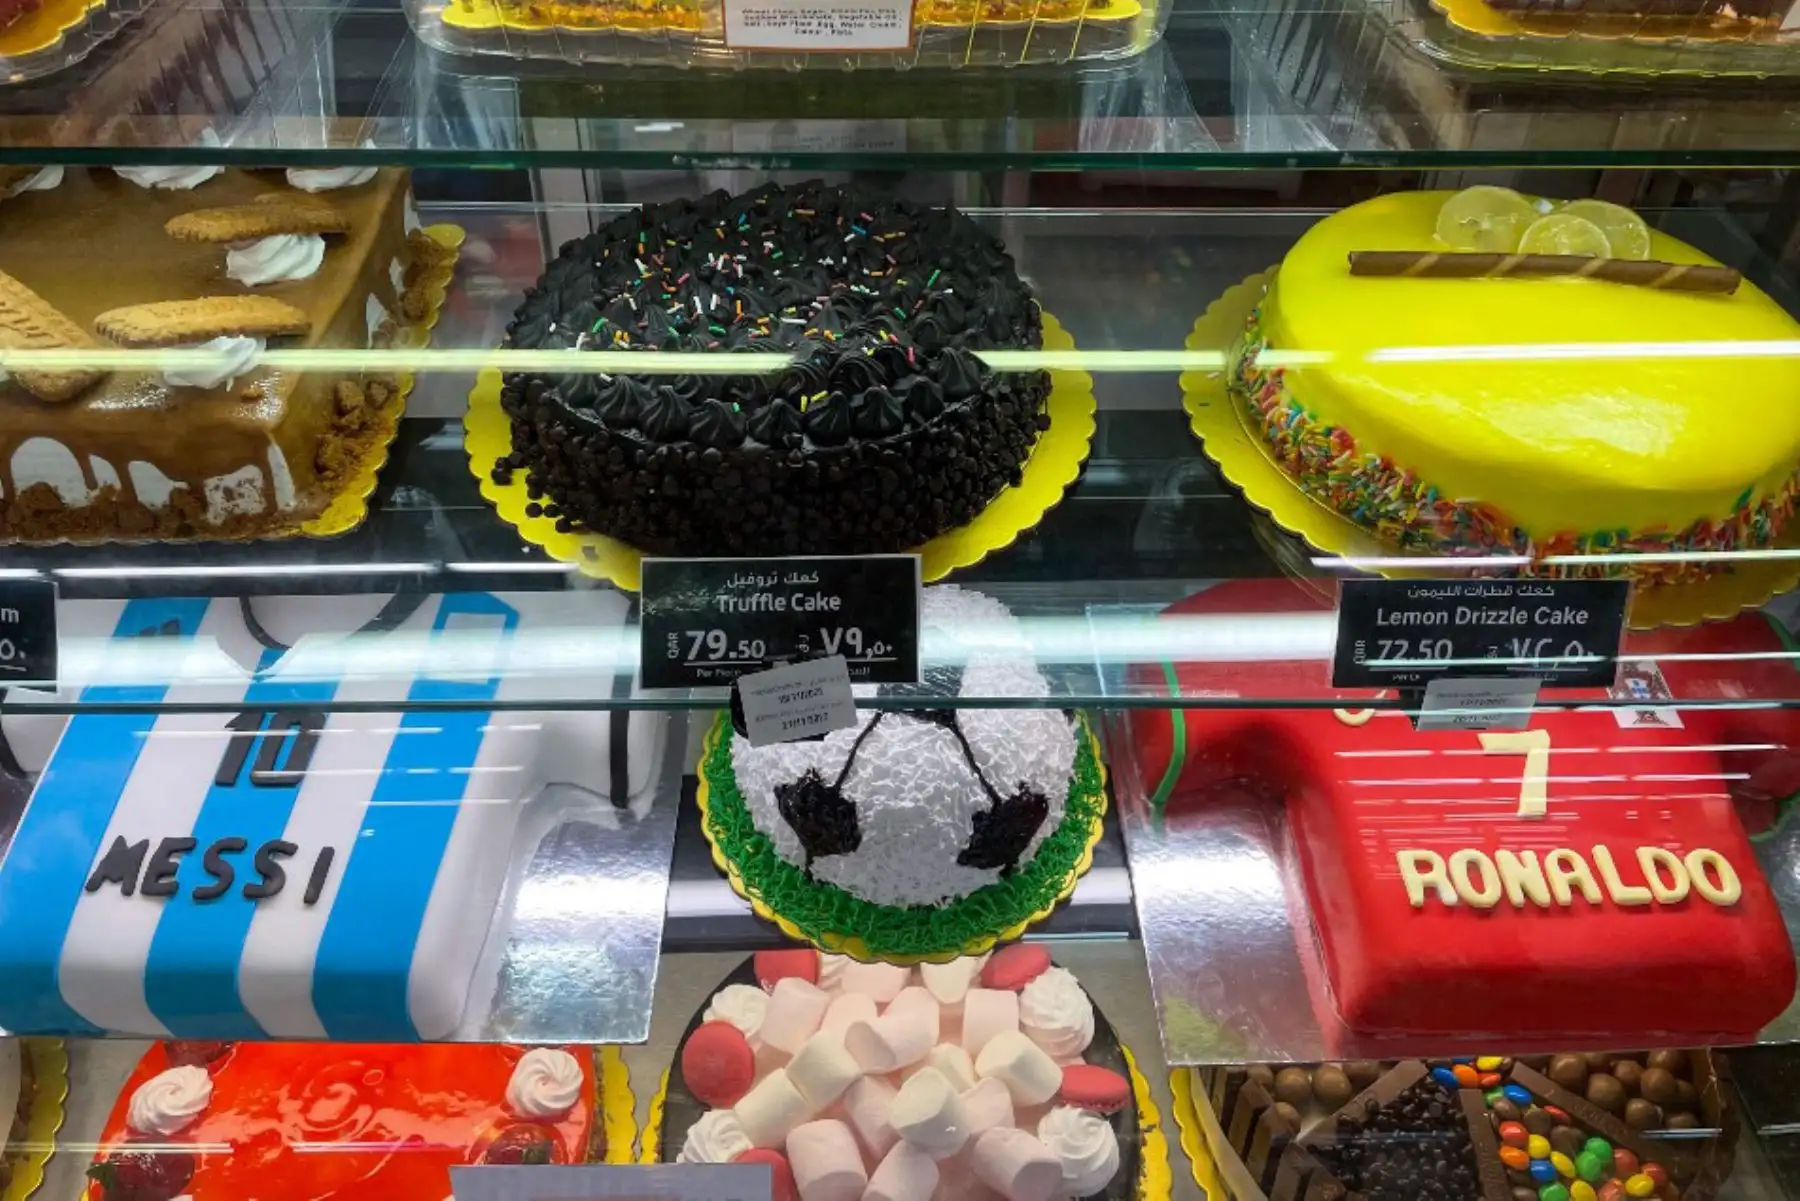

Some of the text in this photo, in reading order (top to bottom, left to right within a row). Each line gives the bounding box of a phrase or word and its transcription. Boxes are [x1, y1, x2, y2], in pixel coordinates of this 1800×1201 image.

[727, 571, 819, 588] كعك تروفيل
[717, 592, 842, 612] Truffle Cake
[1376, 606, 1589, 626] Lemon Drizzle Cake
[685, 629, 766, 660] 79.50
[1376, 638, 1453, 661] 72.50
[214, 711, 328, 788] 10
[1477, 729, 1551, 818] 7
[85, 835, 335, 905] MESSI
[1396, 844, 1742, 908] RONALDO
